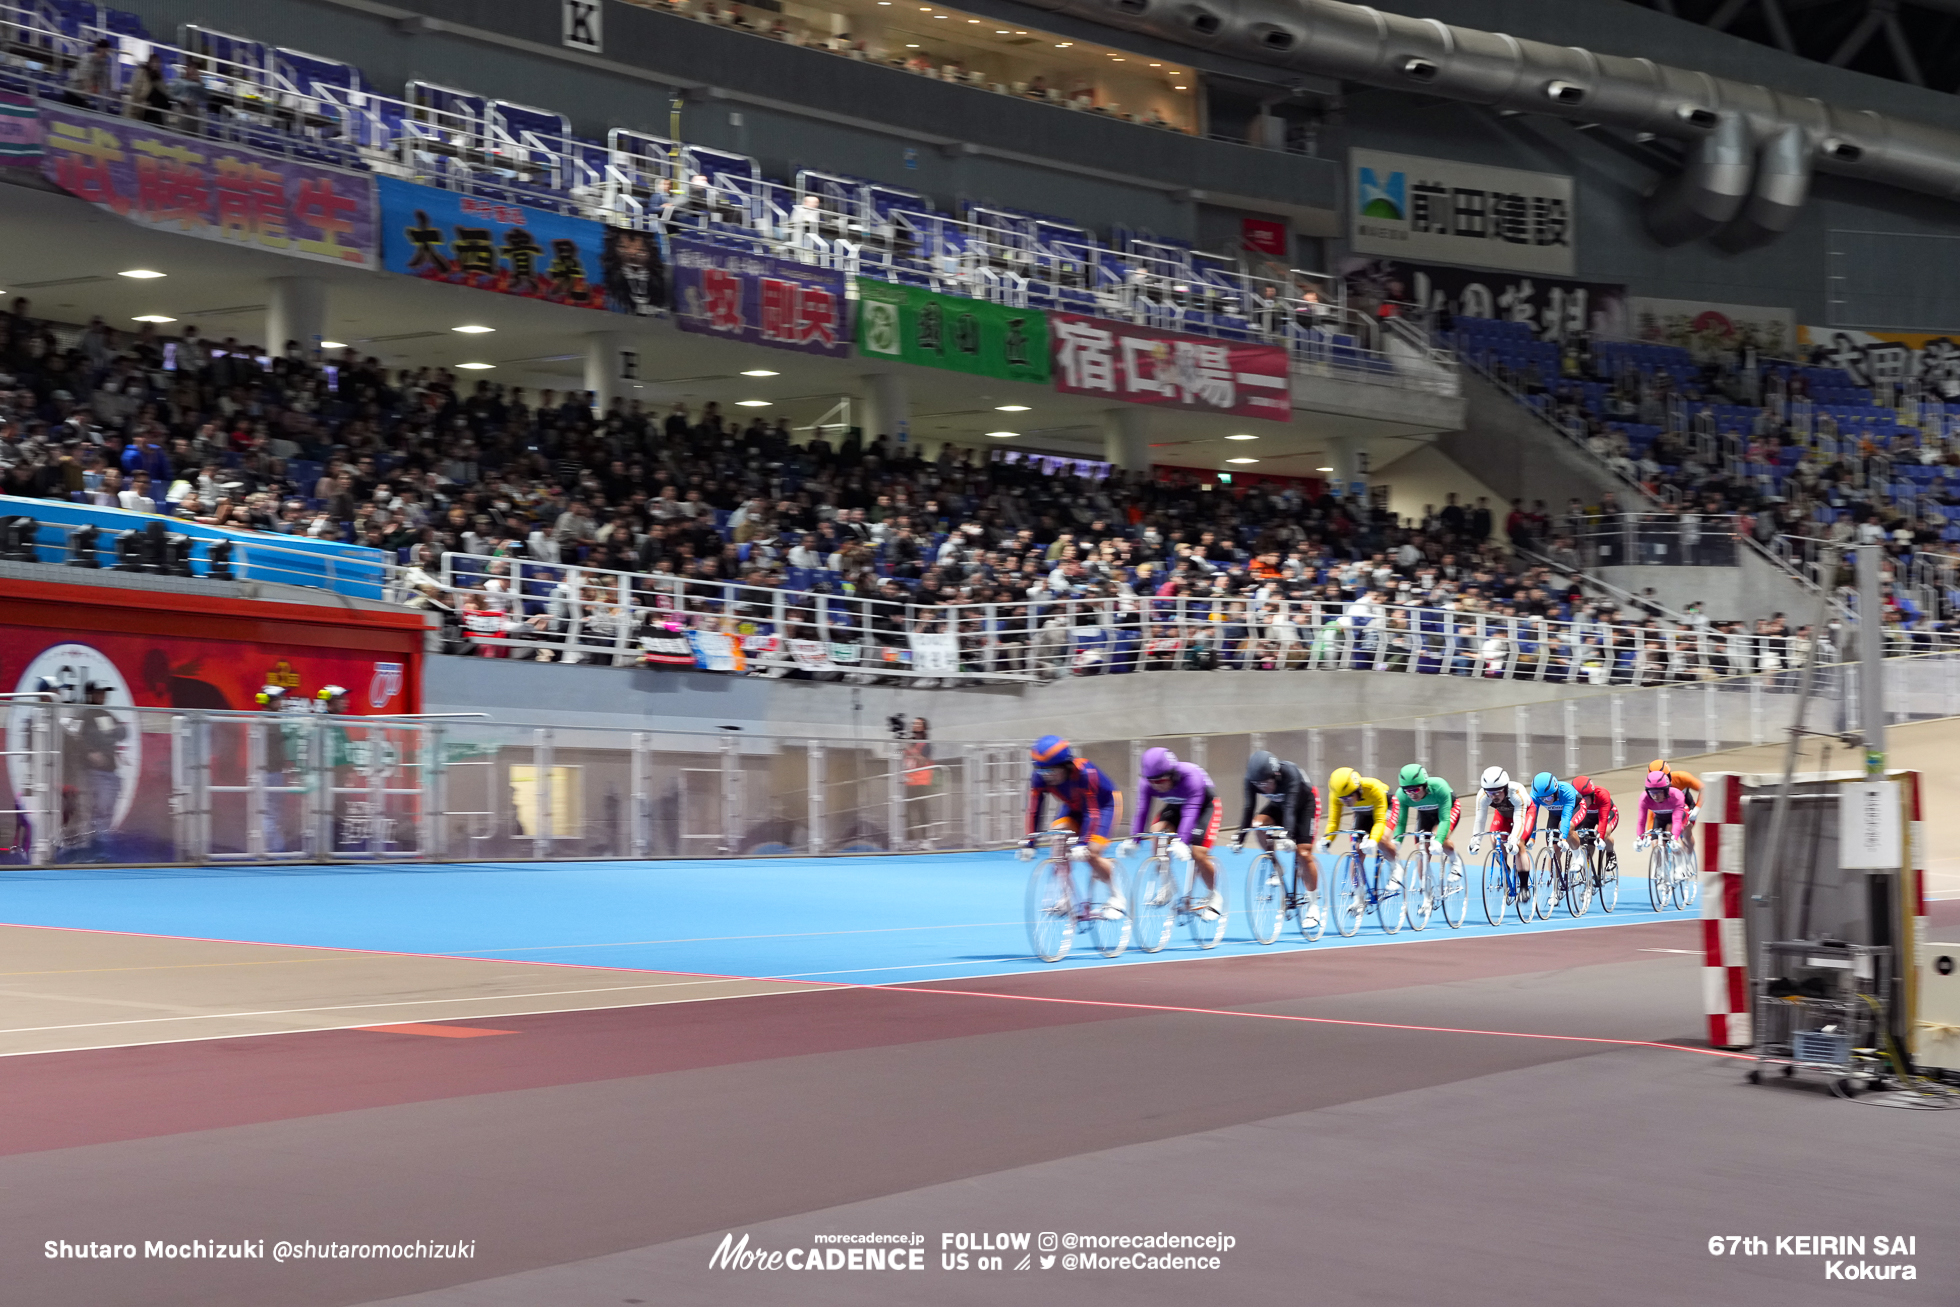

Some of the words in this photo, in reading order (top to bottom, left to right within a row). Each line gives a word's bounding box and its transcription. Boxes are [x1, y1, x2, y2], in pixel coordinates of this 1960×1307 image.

[567, 0, 599, 46] K
[1410, 179, 1569, 247] 前田建設
